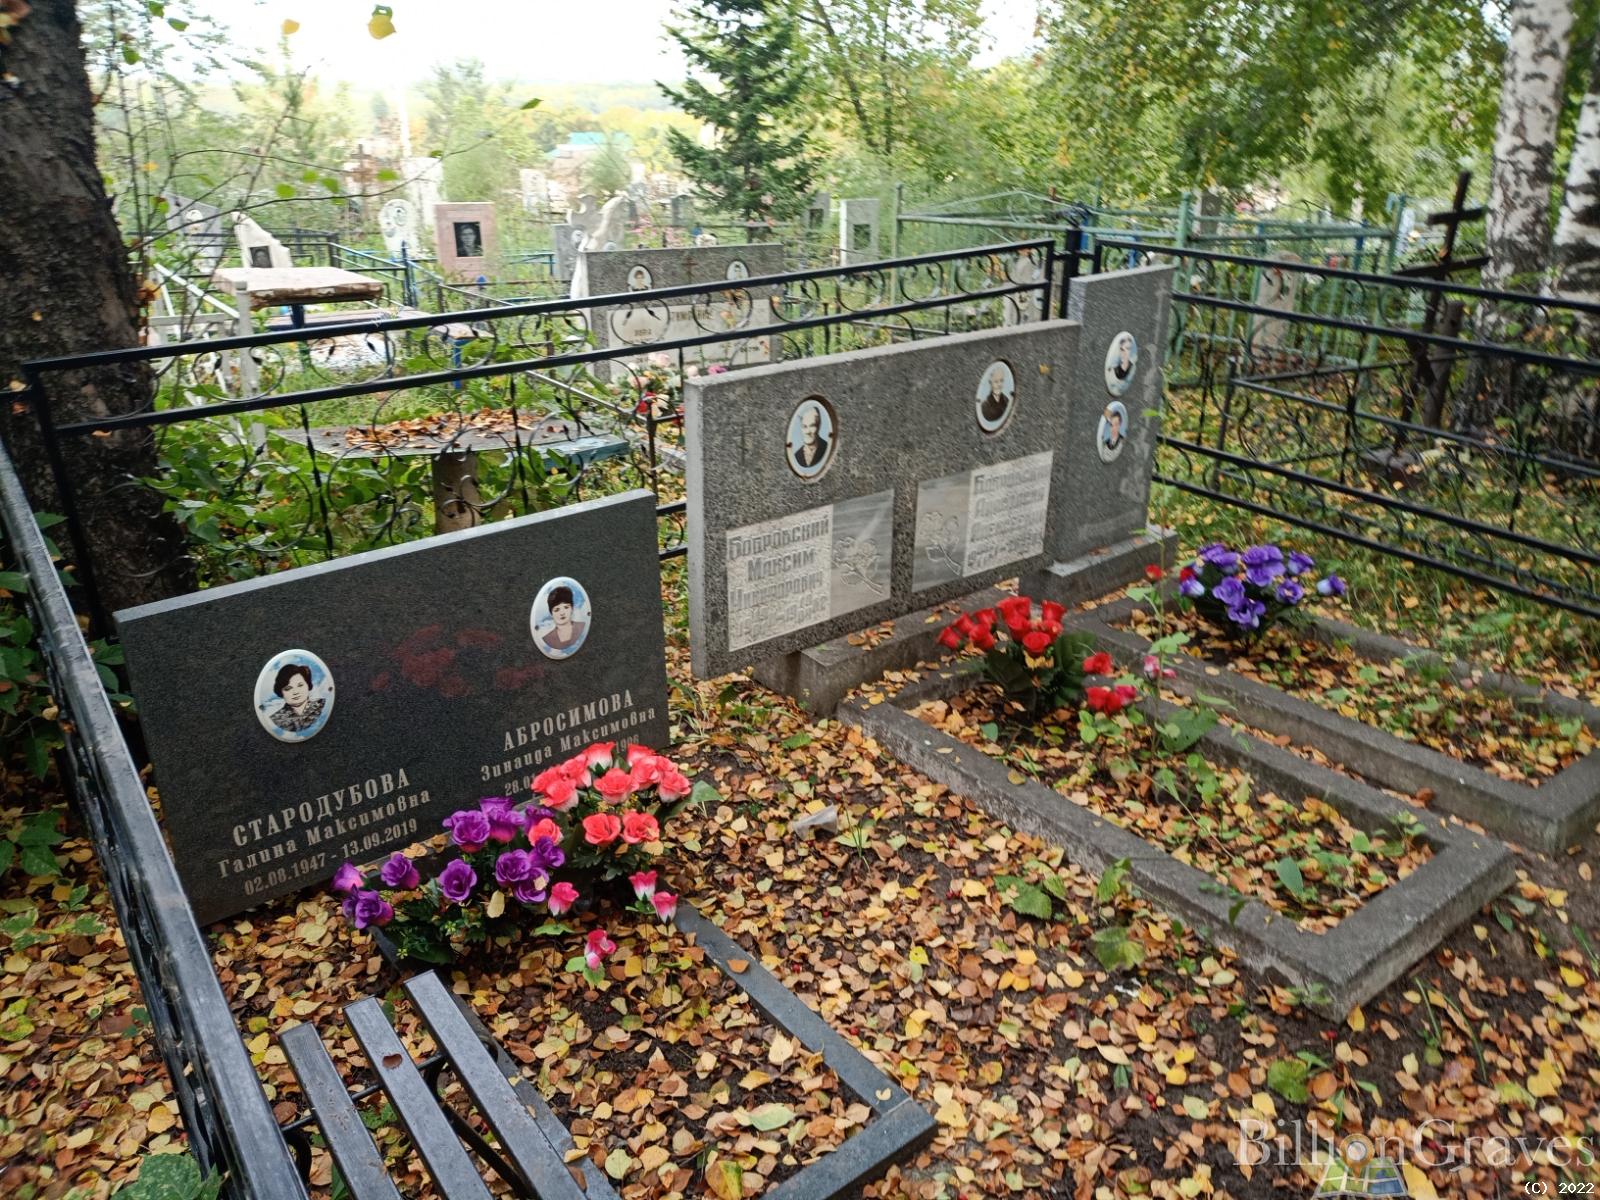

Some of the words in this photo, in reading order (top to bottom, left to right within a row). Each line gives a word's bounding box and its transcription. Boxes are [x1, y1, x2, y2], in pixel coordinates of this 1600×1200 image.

[480, 745, 553, 781] Зинаида
[559, 707, 656, 753] Максимовна
[503, 689, 634, 752] АБРОСИМОВА
[217, 838, 298, 879] Галина
[305, 789, 432, 847] Максимовна
[232, 768, 411, 847] СТАРОДУБОВА
[244, 852, 327, 897] 02.08.1947
[343, 818, 419, 859] 13.09.2019
